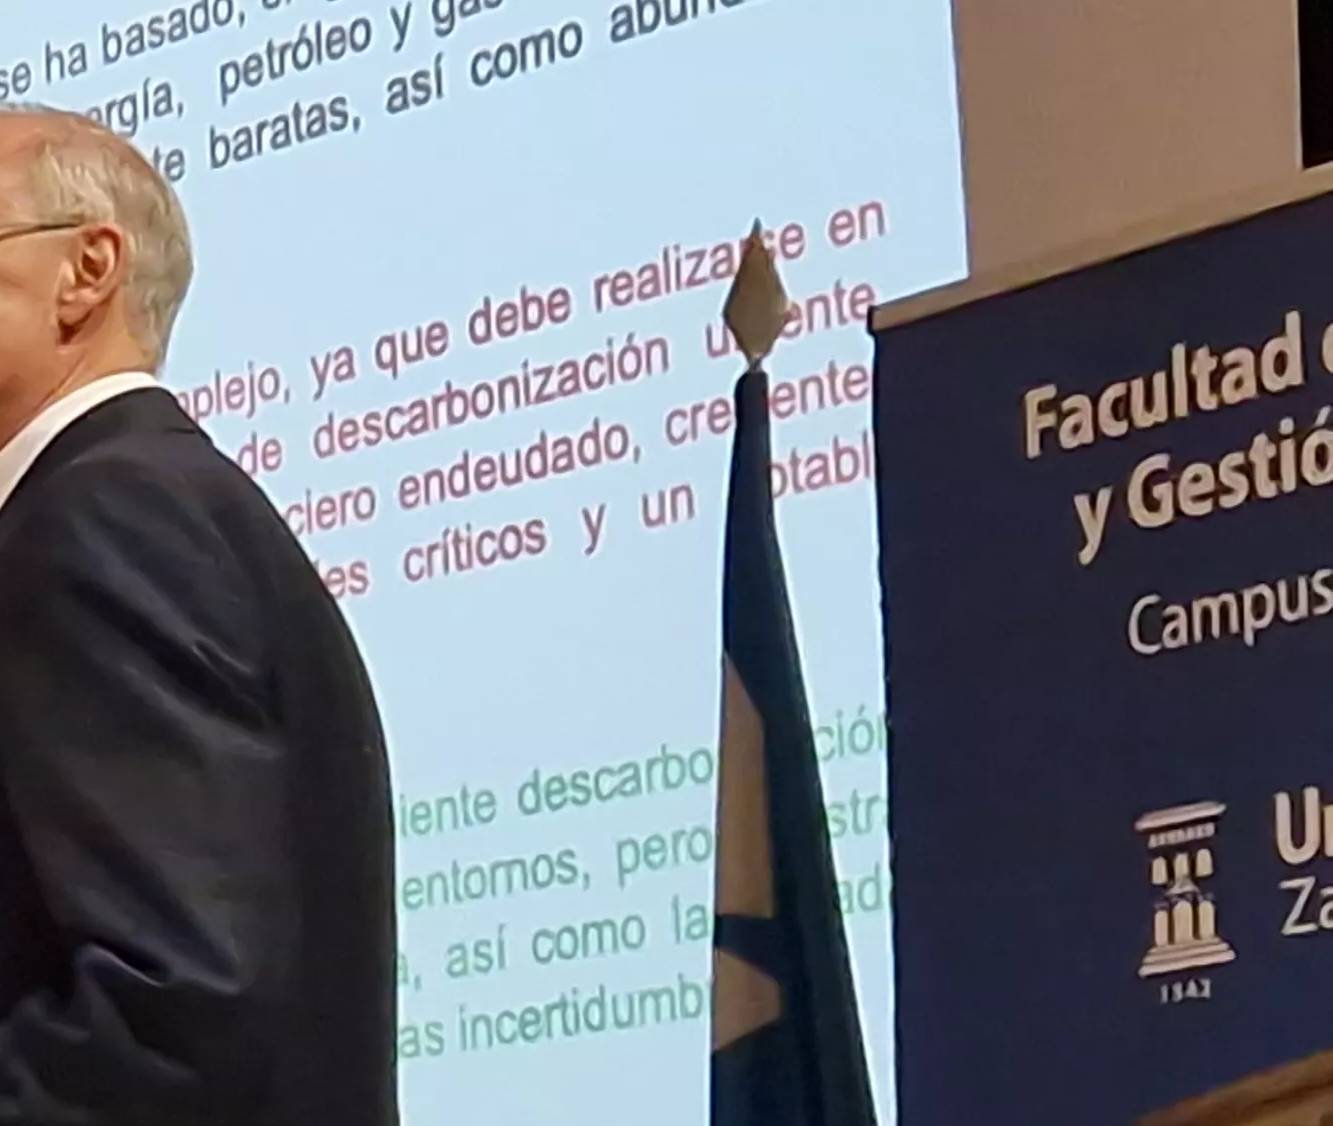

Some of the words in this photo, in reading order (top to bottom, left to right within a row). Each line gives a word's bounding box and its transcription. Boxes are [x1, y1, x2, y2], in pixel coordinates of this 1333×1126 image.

[45, 41, 88, 84] ha
[209, 96, 361, 170] baratas,
[385, 53, 443, 115] así
[470, 21, 583, 88] como
[220, 18, 372, 107] petróleo
[391, 2, 412, 52] y
[311, 345, 356, 401] ya
[375, 322, 449, 380] que
[469, 287, 571, 348] debe
[828, 201, 885, 247] en
[312, 332, 670, 459] descarbonización
[706, 279, 877, 358] uente
[398, 417, 641, 510] endeudado,
[666, 360, 869, 446] creente
[1025, 310, 1305, 459] Facultad
[315, 558, 369, 598] es
[403, 520, 546, 582] críticos
[582, 503, 606, 556] y
[643, 483, 695, 528] un
[770, 429, 871, 499] otabl
[1074, 485, 1113, 566] y
[1128, 405, 1333, 529] Gestió
[1128, 568, 1333, 655] Campus
[617, 826, 713, 889] pero
[445, 922, 507, 979] así
[532, 914, 646, 965] como
[459, 972, 705, 1052] incertidumb
